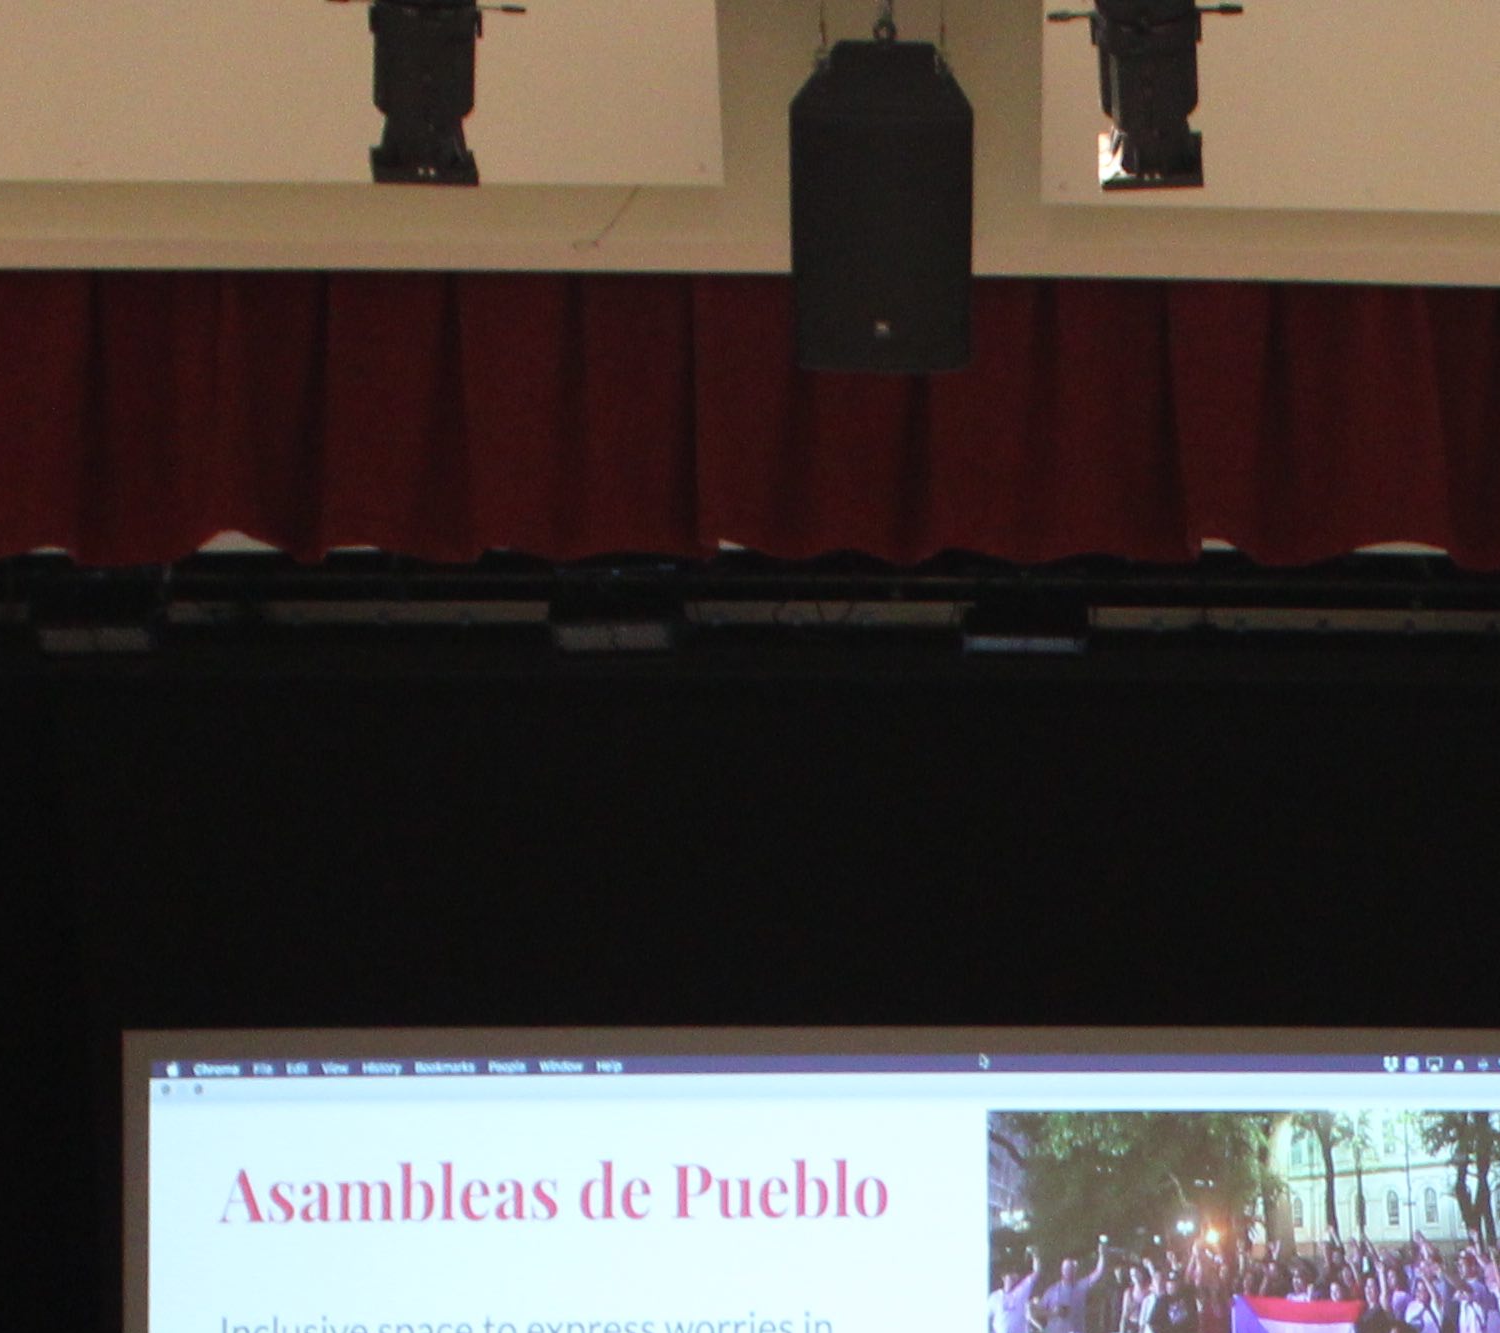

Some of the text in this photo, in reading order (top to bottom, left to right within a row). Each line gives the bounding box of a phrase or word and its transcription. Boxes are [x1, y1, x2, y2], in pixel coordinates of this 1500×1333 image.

[321, 1062, 349, 1075] View
[362, 1061, 402, 1076] History
[414, 1060, 476, 1074] Bookmarks
[539, 1060, 584, 1073] Window
[596, 1060, 624, 1074] Help
[219, 1158, 889, 1224] Asambleas de Pueblo
